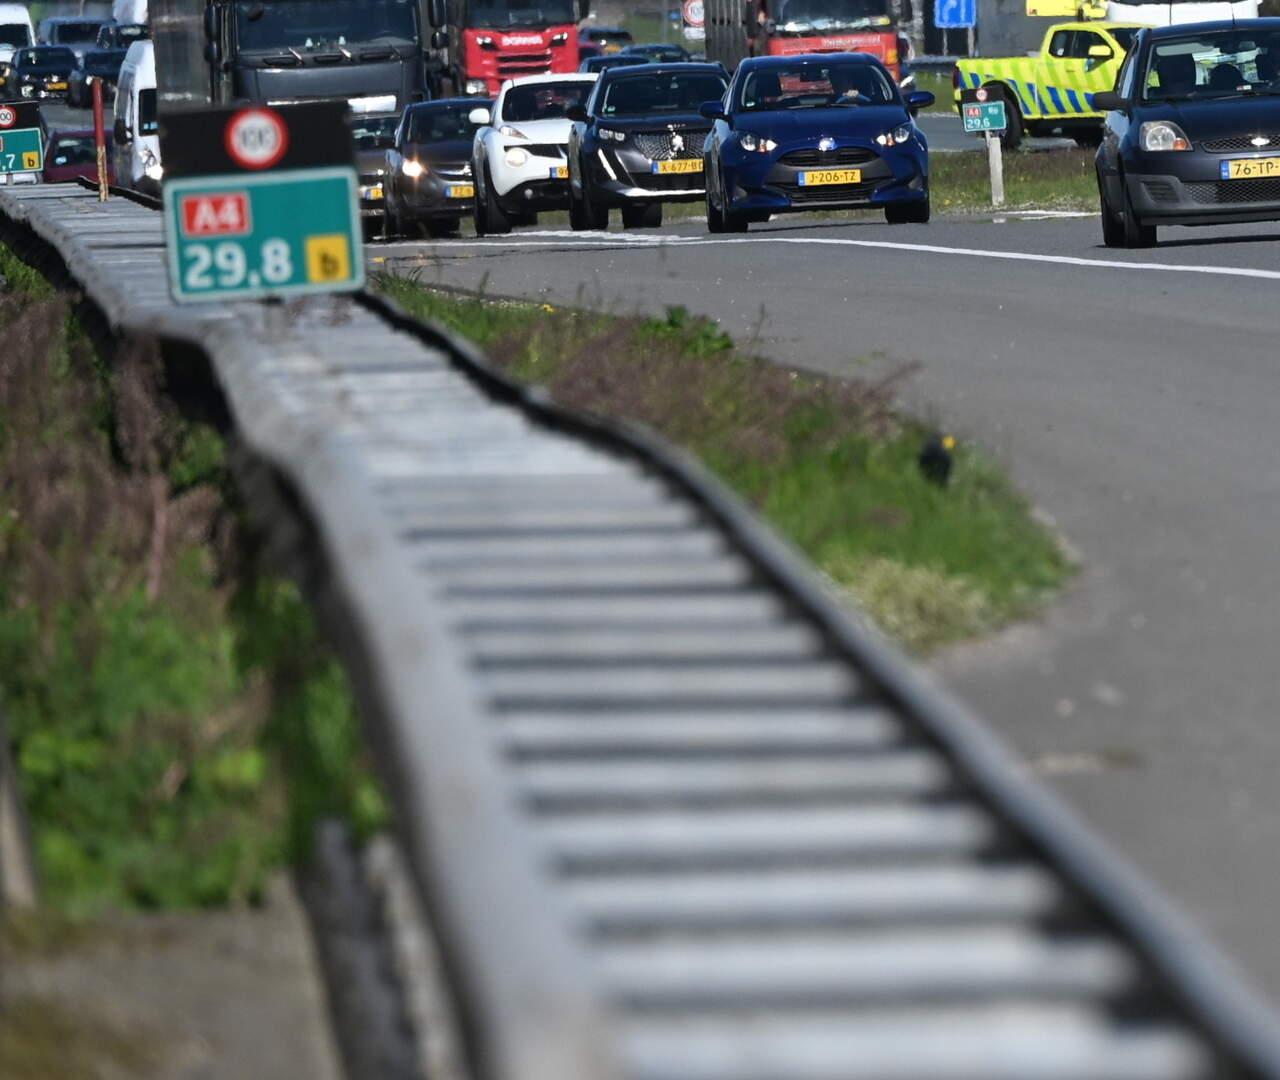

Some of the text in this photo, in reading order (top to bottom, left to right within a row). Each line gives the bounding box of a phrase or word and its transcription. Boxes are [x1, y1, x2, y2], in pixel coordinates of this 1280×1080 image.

[809, 172, 857, 184] J-206-TZ
[194, 198, 241, 231] A4
[319, 252, 340, 279] b
